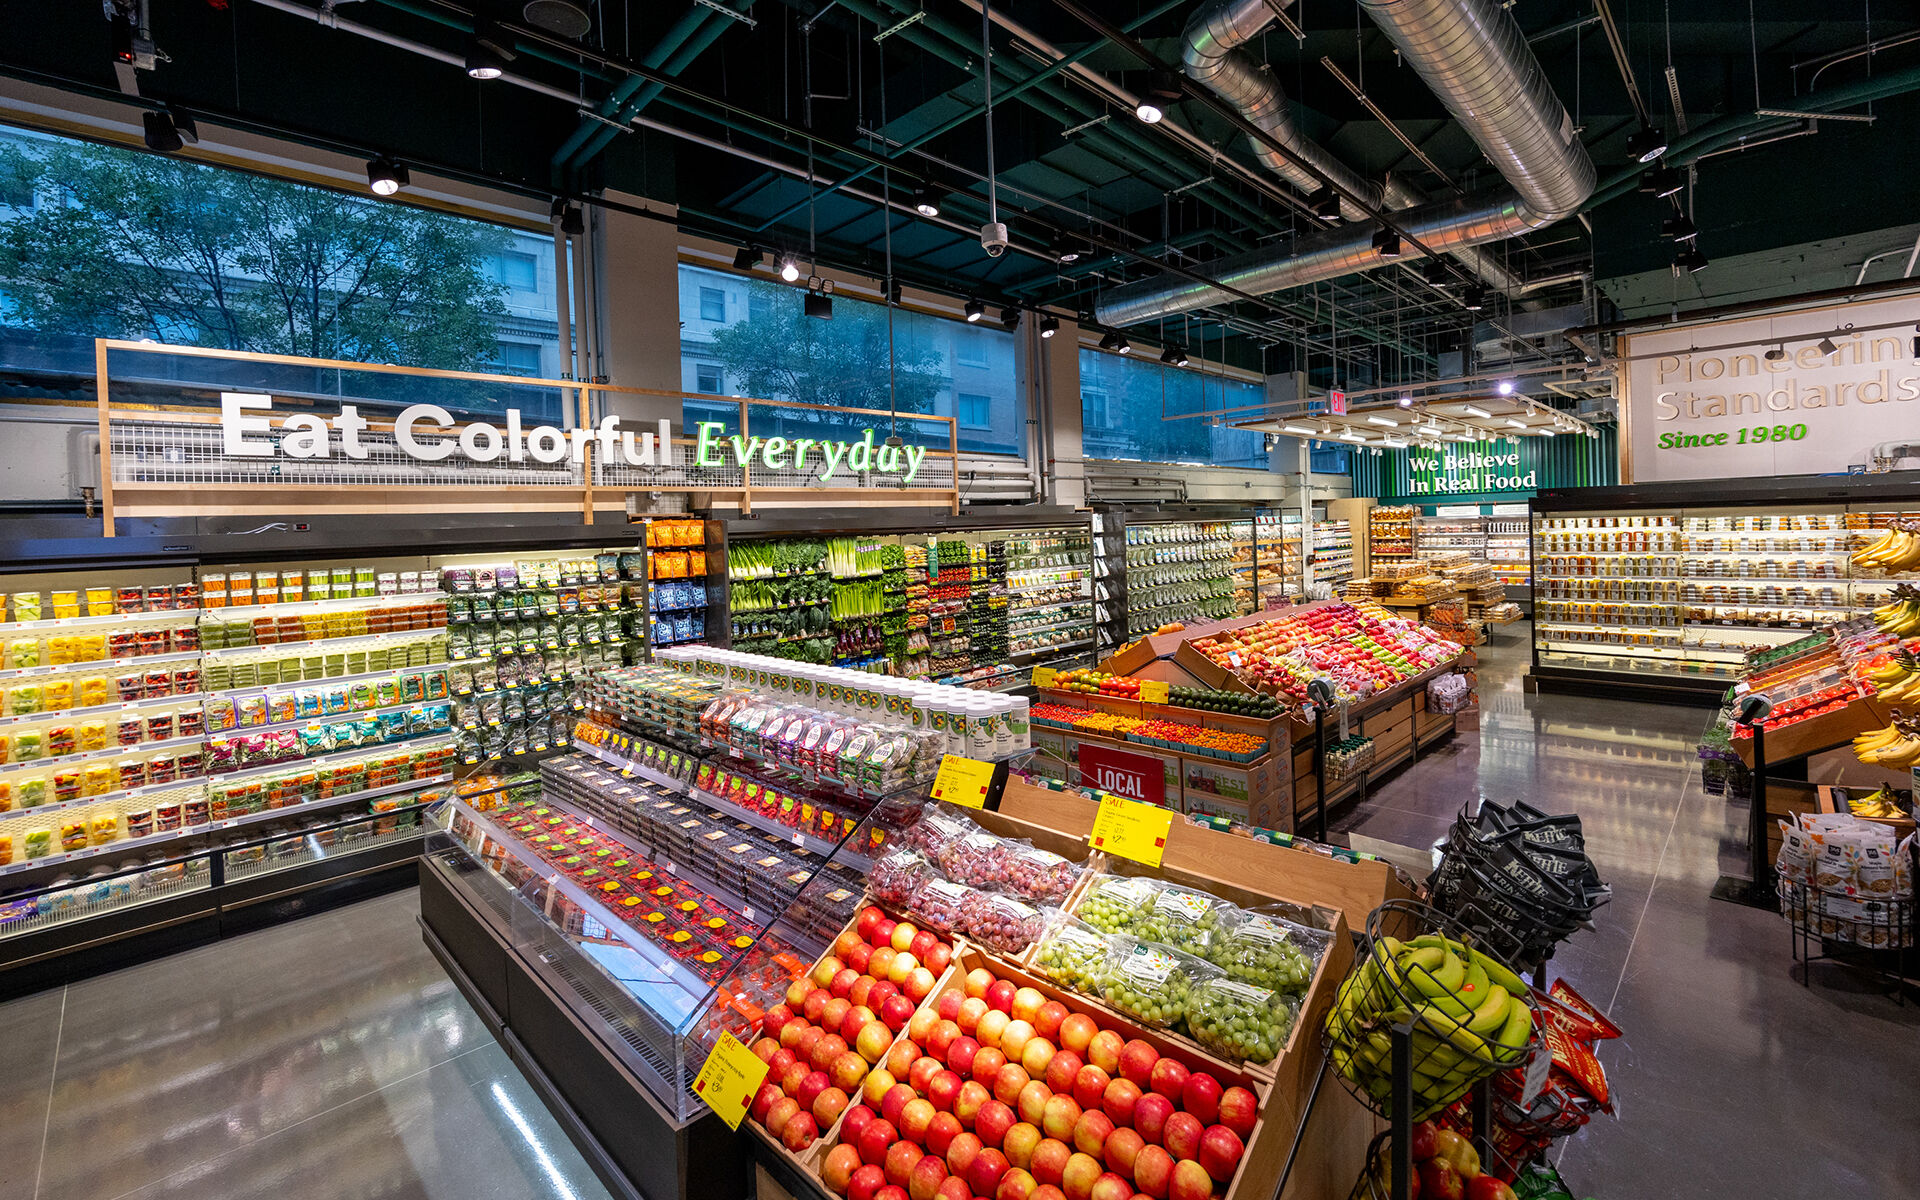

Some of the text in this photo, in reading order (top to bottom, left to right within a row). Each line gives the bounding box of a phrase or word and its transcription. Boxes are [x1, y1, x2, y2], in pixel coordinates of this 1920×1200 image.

[1656, 369, 1920, 422] Standards
[221, 392, 927, 483] Eat Colorful Everyday
[1657, 423, 1808, 449] Since 1980
[1408, 452, 1520, 472] We Believe
[1409, 470, 1538, 494] In Real Food
[1097, 768, 1145, 799] LOCAL
[1213, 775, 1246, 792] BEST
[1105, 796, 1125, 809] SALE
[1502, 856, 1550, 898] KETTLE
[721, 1033, 739, 1052] SALE
